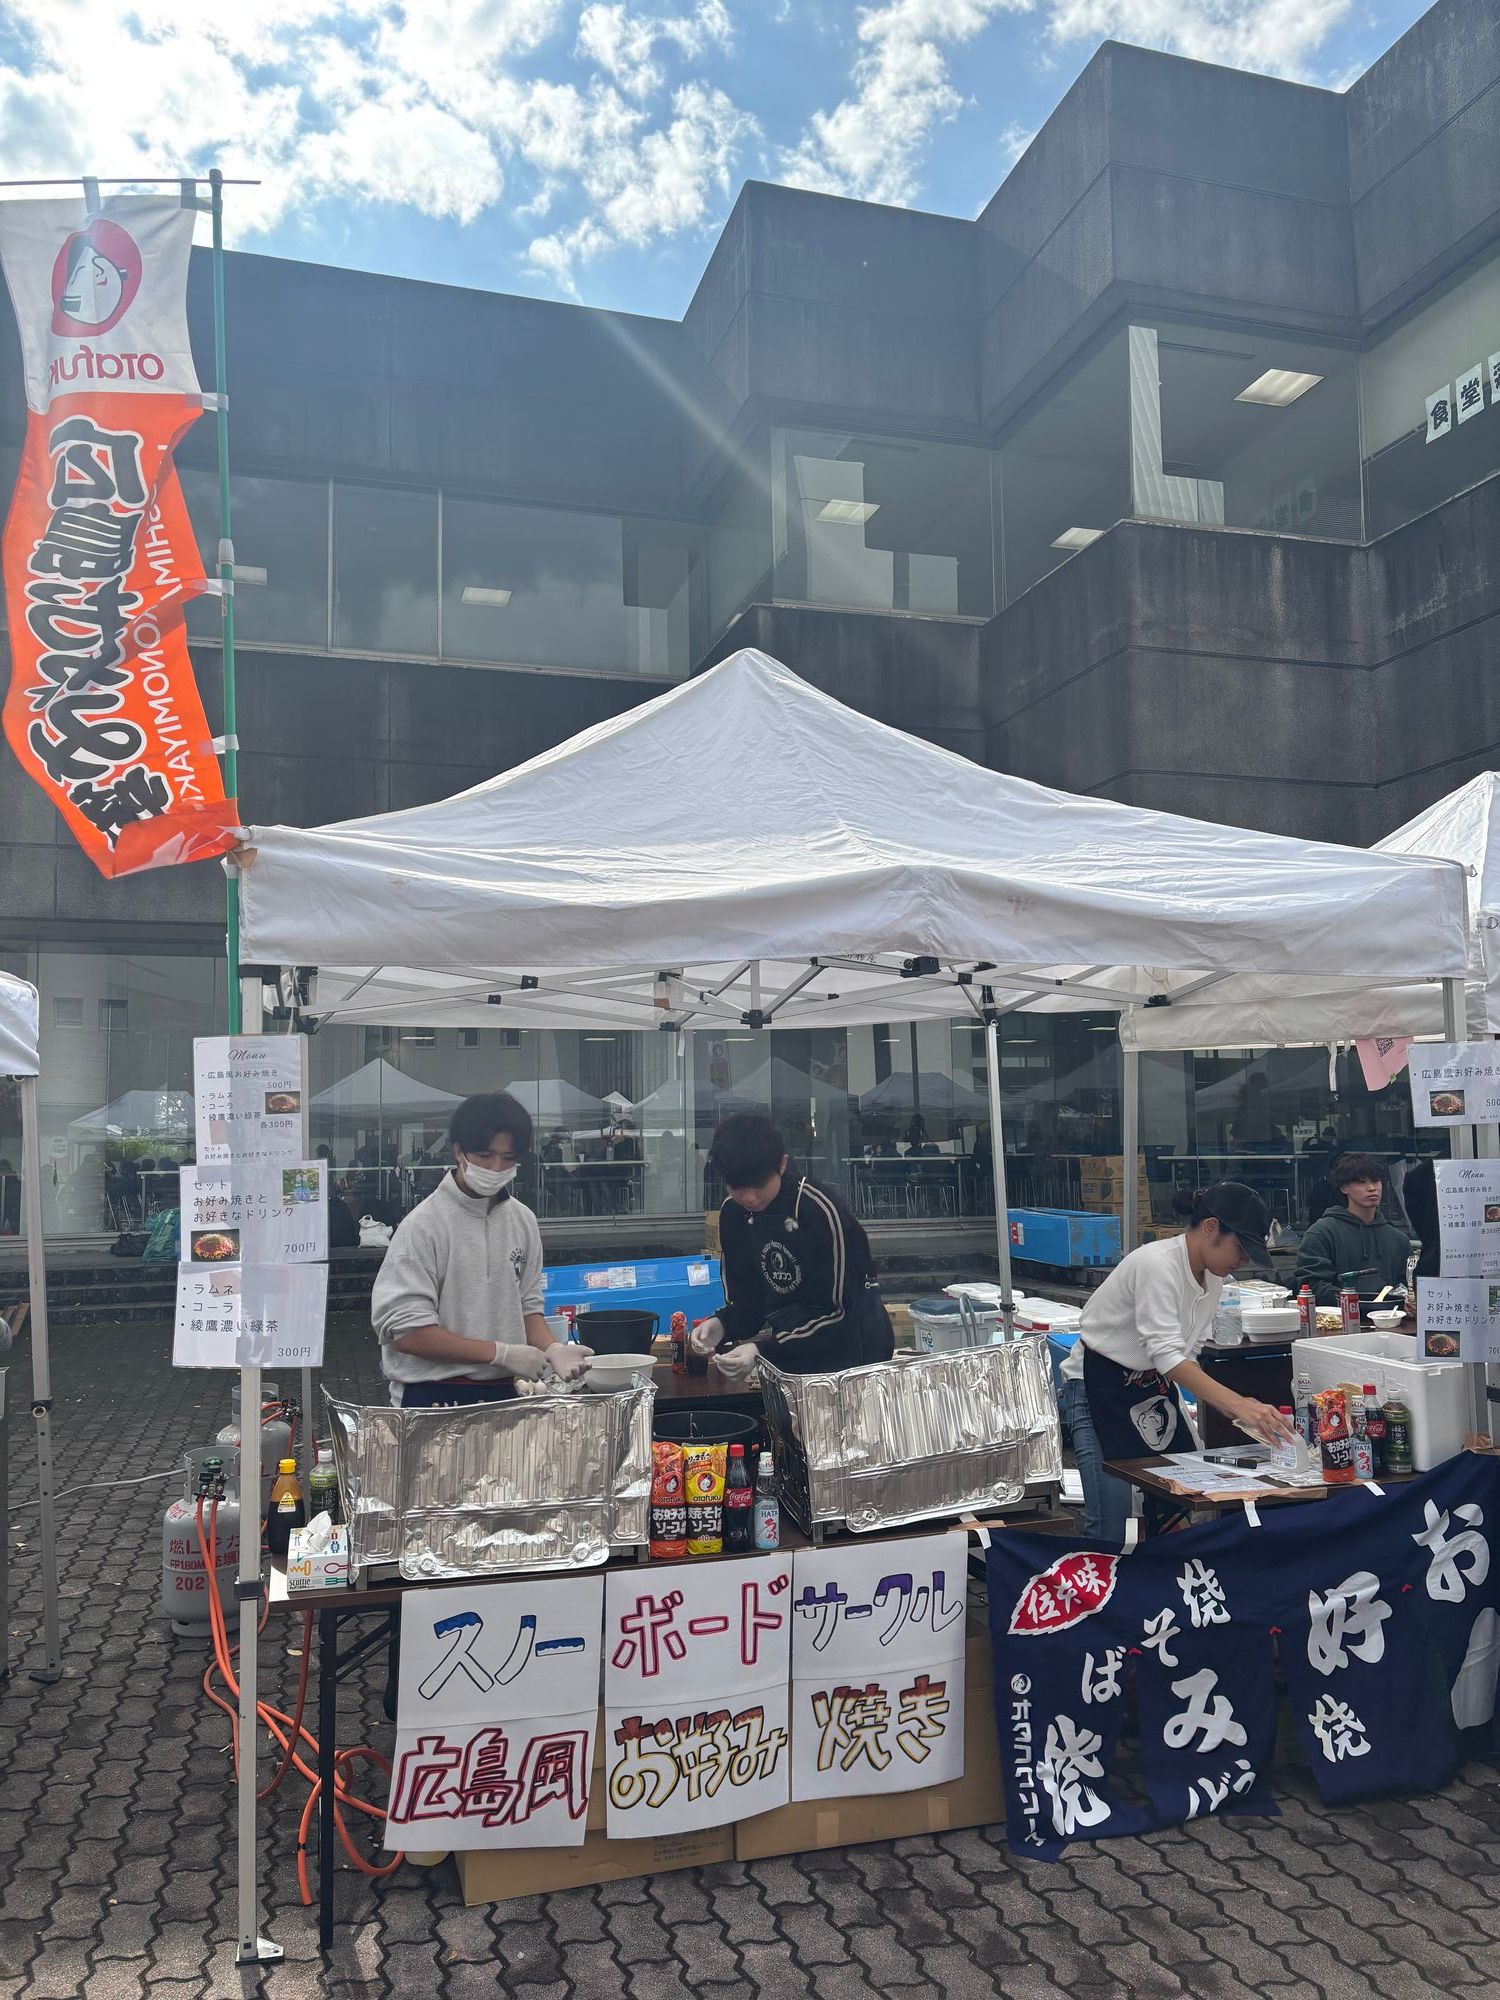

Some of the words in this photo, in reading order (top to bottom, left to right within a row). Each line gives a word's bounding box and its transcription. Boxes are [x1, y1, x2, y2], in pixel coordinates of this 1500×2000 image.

[228, 1049, 269, 1061] Menu
[267, 1081, 292, 1089] 500円
[1458, 1169, 1485, 1179] Menu
[193, 1180, 228, 1191] セット
[193, 1194, 268, 1207] お好み焼きと
[193, 1208, 293, 1223] お好きなドリンク
[284, 1242, 316, 1254] 700円
[193, 1283, 235, 1295] ラムネ
[192, 1302, 234, 1313] コーラ
[190, 1319, 280, 1333] 綾鷹濃い緑茶
[277, 1347, 311, 1358] 300円
[289, 1577, 311, 1586] scottie
[417, 1611, 585, 1700] スノー
[611, 1574, 790, 1678] ボード
[794, 1570, 964, 1652] サークル
[388, 1727, 589, 1827] 広島風
[610, 1705, 788, 1810] お好み
[811, 1673, 950, 1772] 焼き
